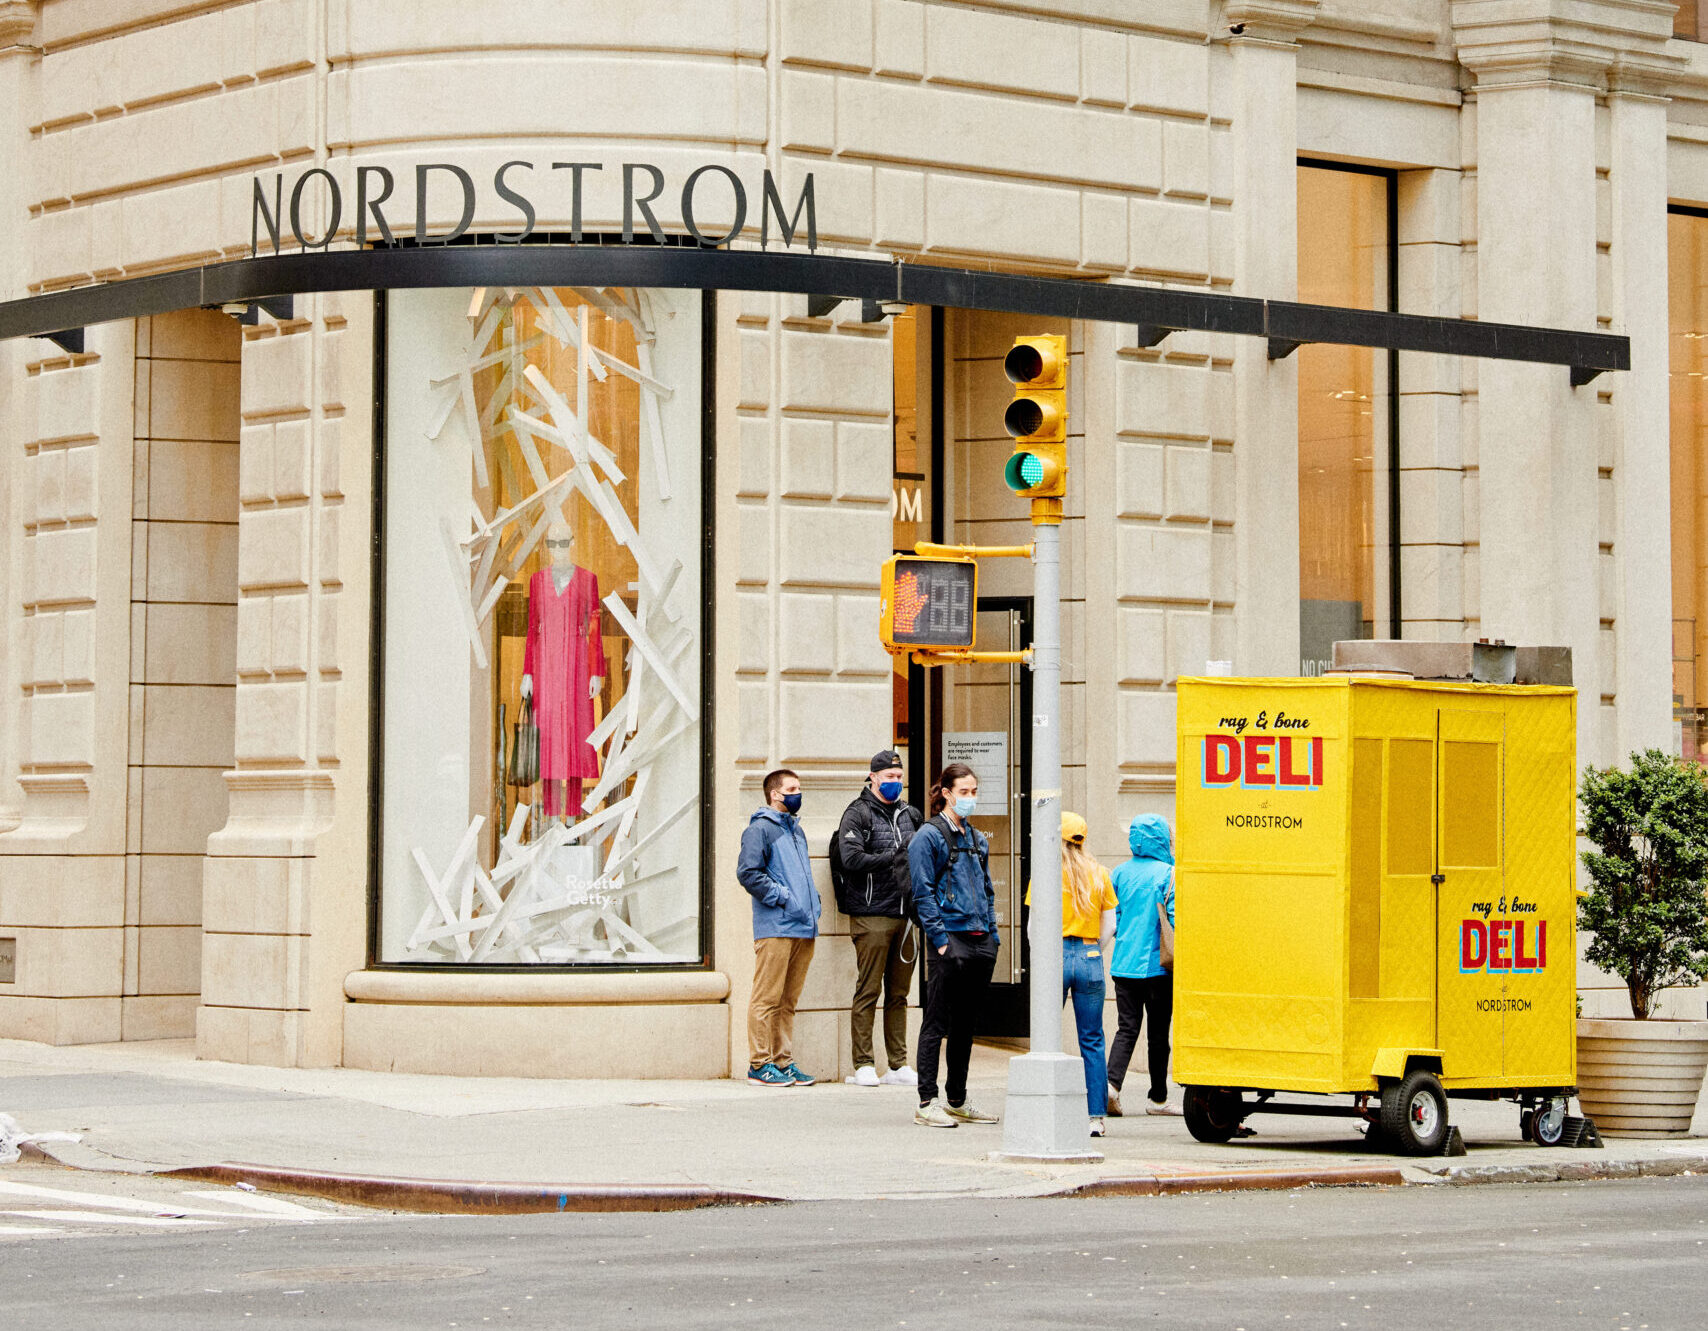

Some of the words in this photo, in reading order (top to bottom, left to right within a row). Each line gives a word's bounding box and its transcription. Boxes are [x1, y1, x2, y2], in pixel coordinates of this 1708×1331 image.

[252, 160, 818, 253] NORDSTROM
[1302, 659, 1316, 677] NO
[1318, 659, 1333, 677] CU
[1219, 716, 1249, 735] rag
[1256, 710, 1268, 730] &
[1273, 711, 1310, 729] bone
[1201, 734, 1323, 791] DELI
[1226, 815, 1303, 829] NORDSTROM
[566, 874, 623, 890] Rosetta
[566, 890, 610, 910] Getty
[1472, 901, 1493, 919] rag
[1498, 896, 1507, 914] &
[1511, 896, 1538, 913] bone
[1459, 919, 1547, 974] DELI
[1476, 999, 1532, 1012] NORDSTROM
